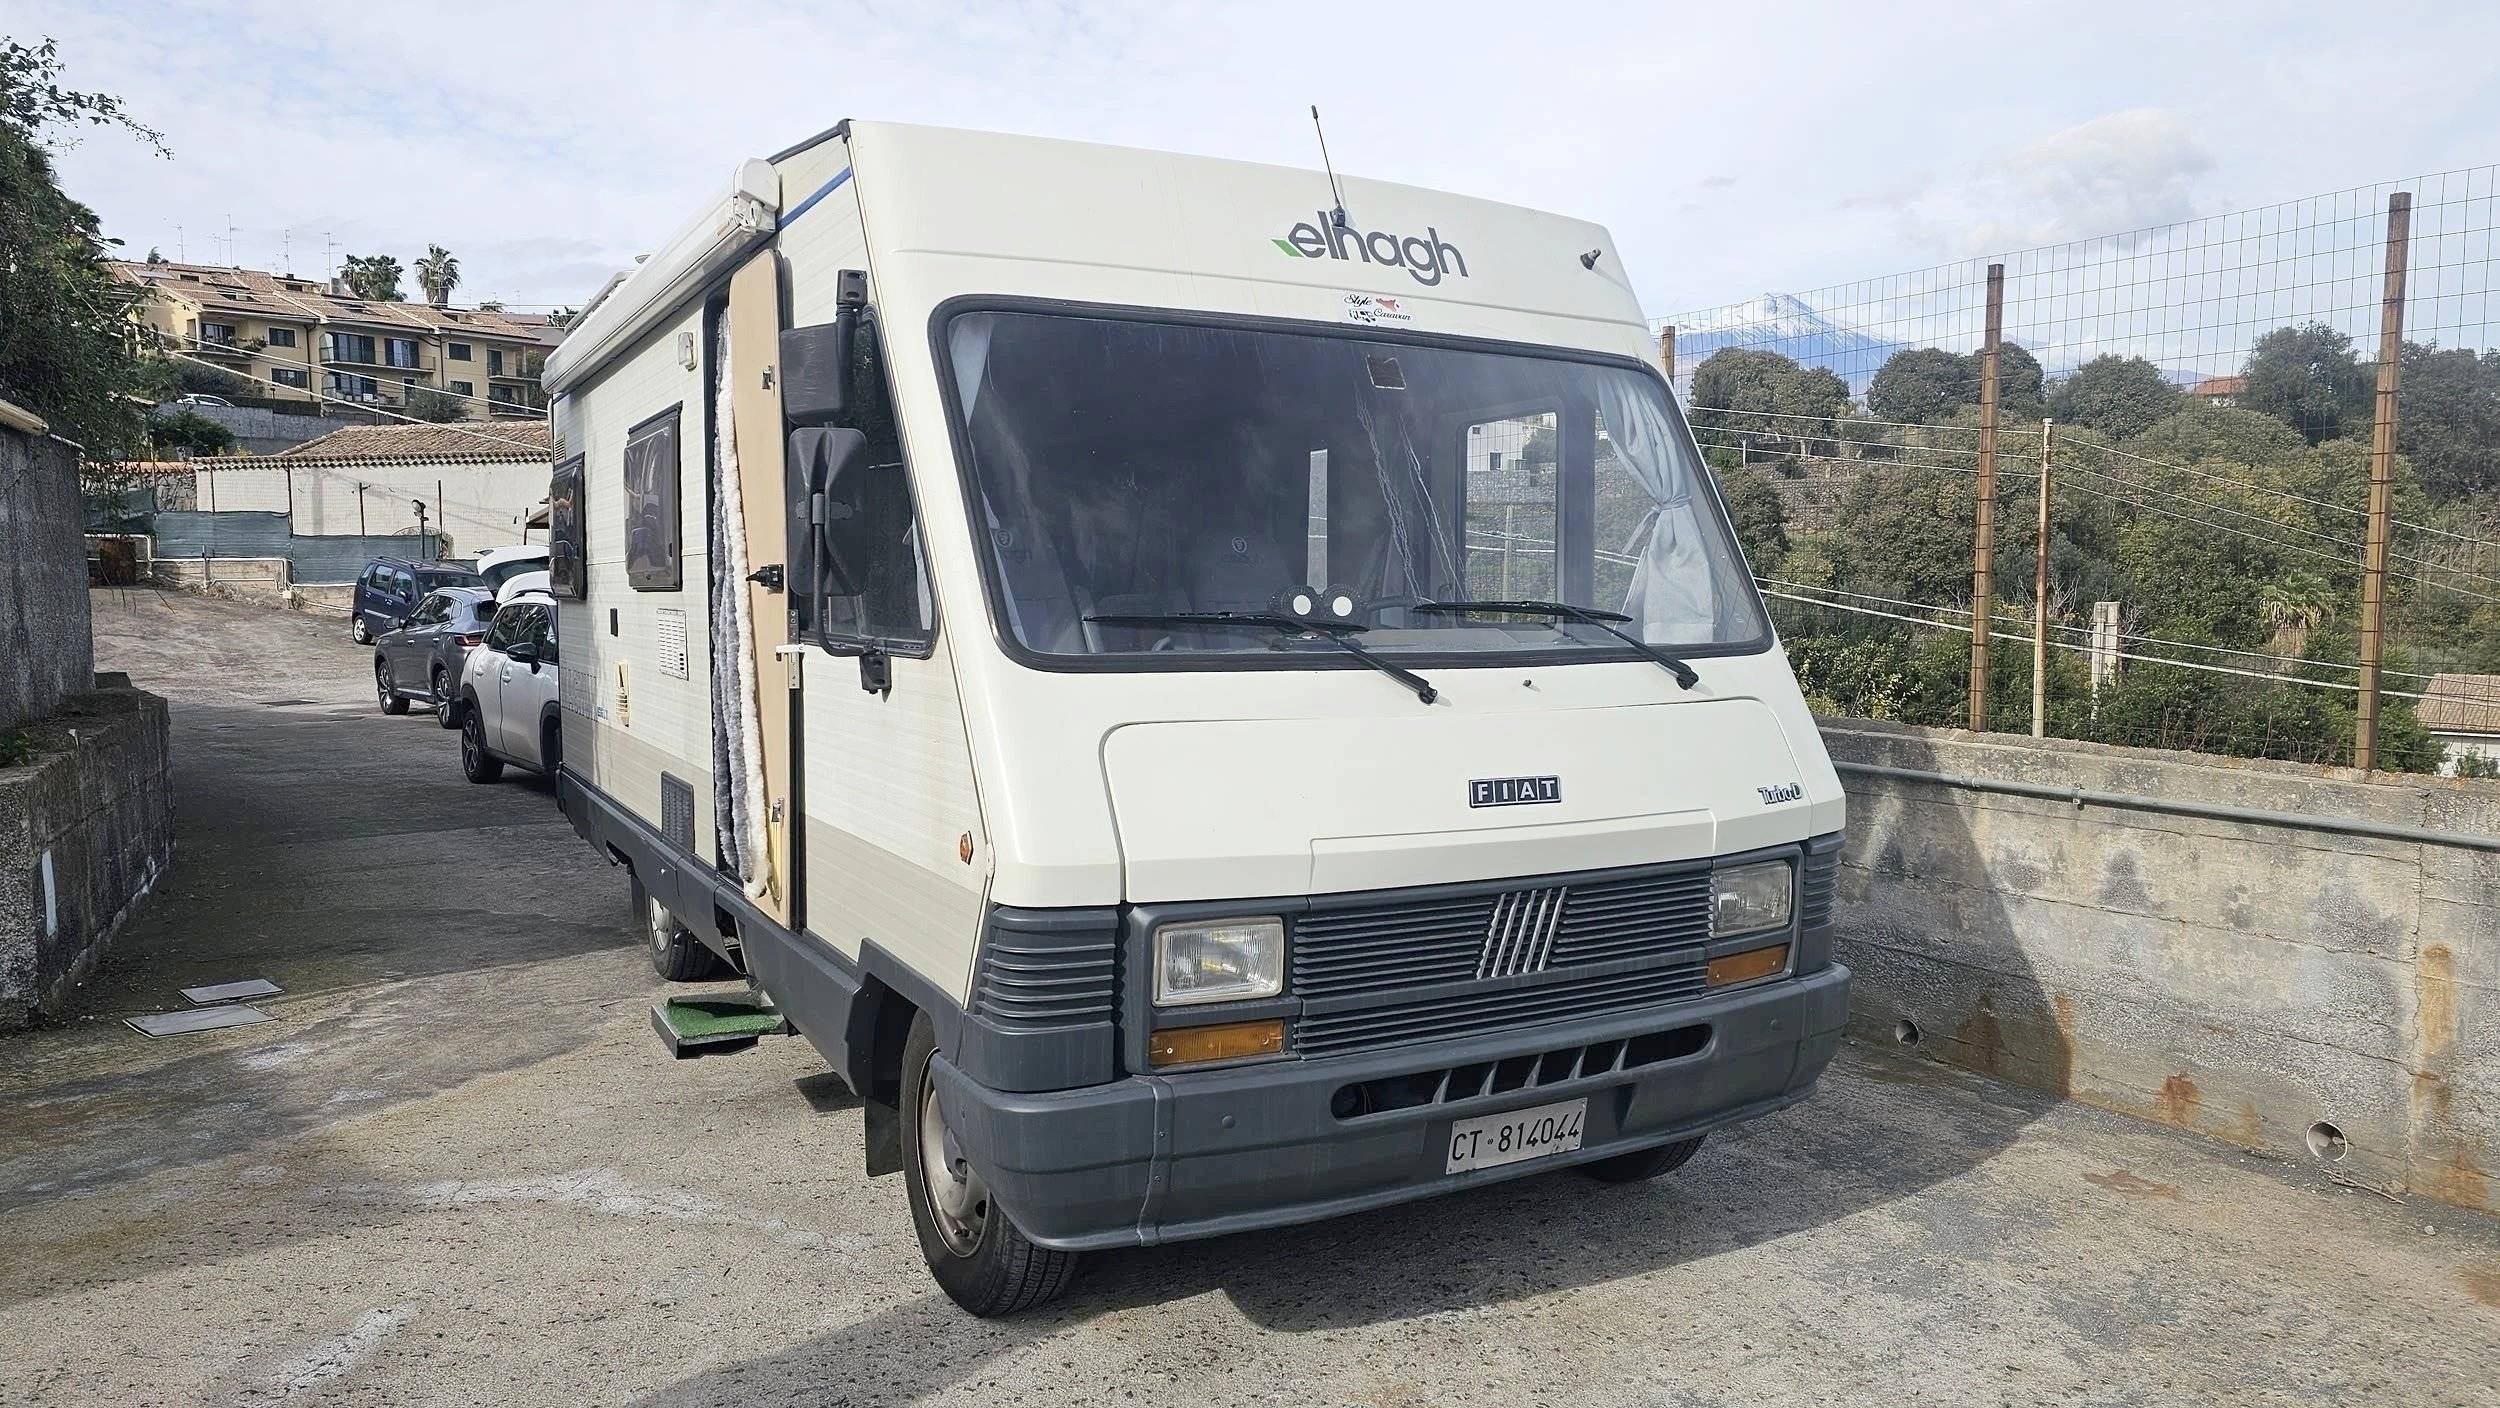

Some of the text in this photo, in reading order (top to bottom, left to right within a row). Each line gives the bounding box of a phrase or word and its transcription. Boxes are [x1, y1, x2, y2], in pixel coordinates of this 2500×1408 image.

[1344, 294, 1373, 308] Style
[1477, 780, 1556, 802] FIAT
[1452, 1111, 1582, 1161] CT 814044
